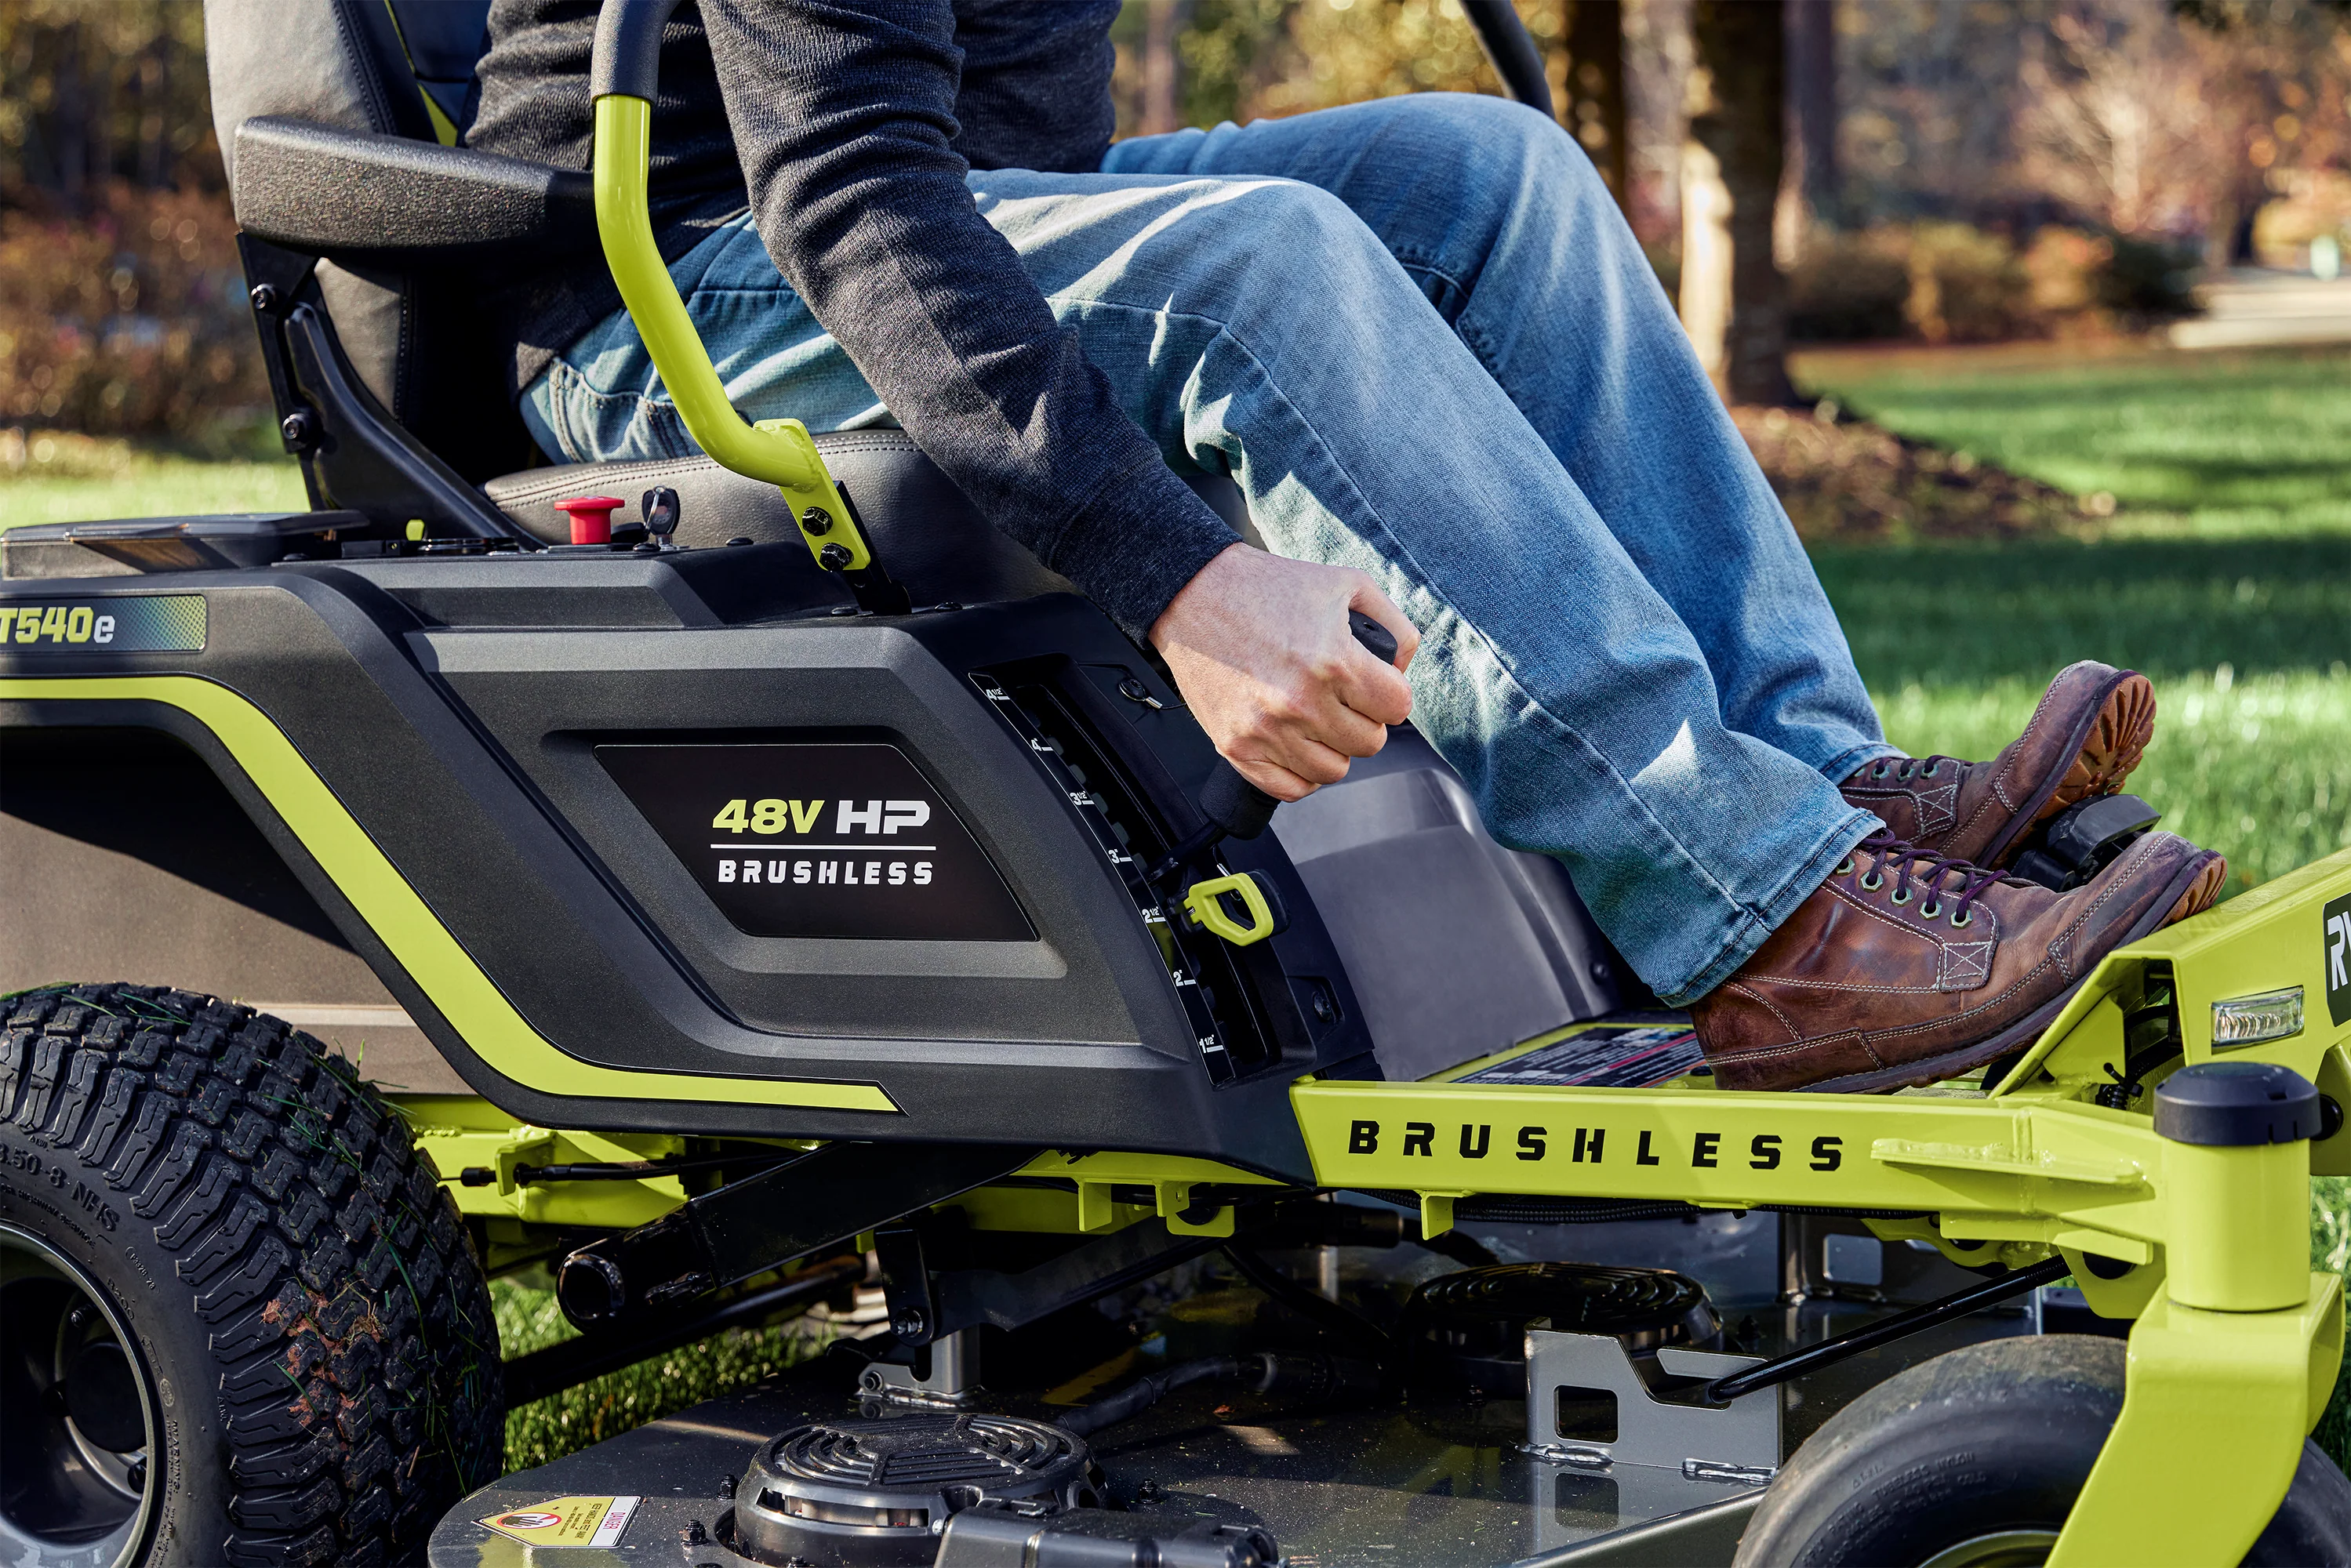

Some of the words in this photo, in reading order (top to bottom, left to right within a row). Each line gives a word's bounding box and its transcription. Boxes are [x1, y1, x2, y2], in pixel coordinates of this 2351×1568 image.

[0, 606, 115, 644] T540e
[712, 798, 825, 834] 48V
[836, 800, 931, 834] HP
[718, 859, 933, 885] BRUSHLESS
[2327, 910, 2351, 992] R
[1347, 1120, 1844, 1172] BRUSHLESS
[17, 1189, 60, 1217] HIGHWAY
[71, 1178, 119, 1232] NHS
